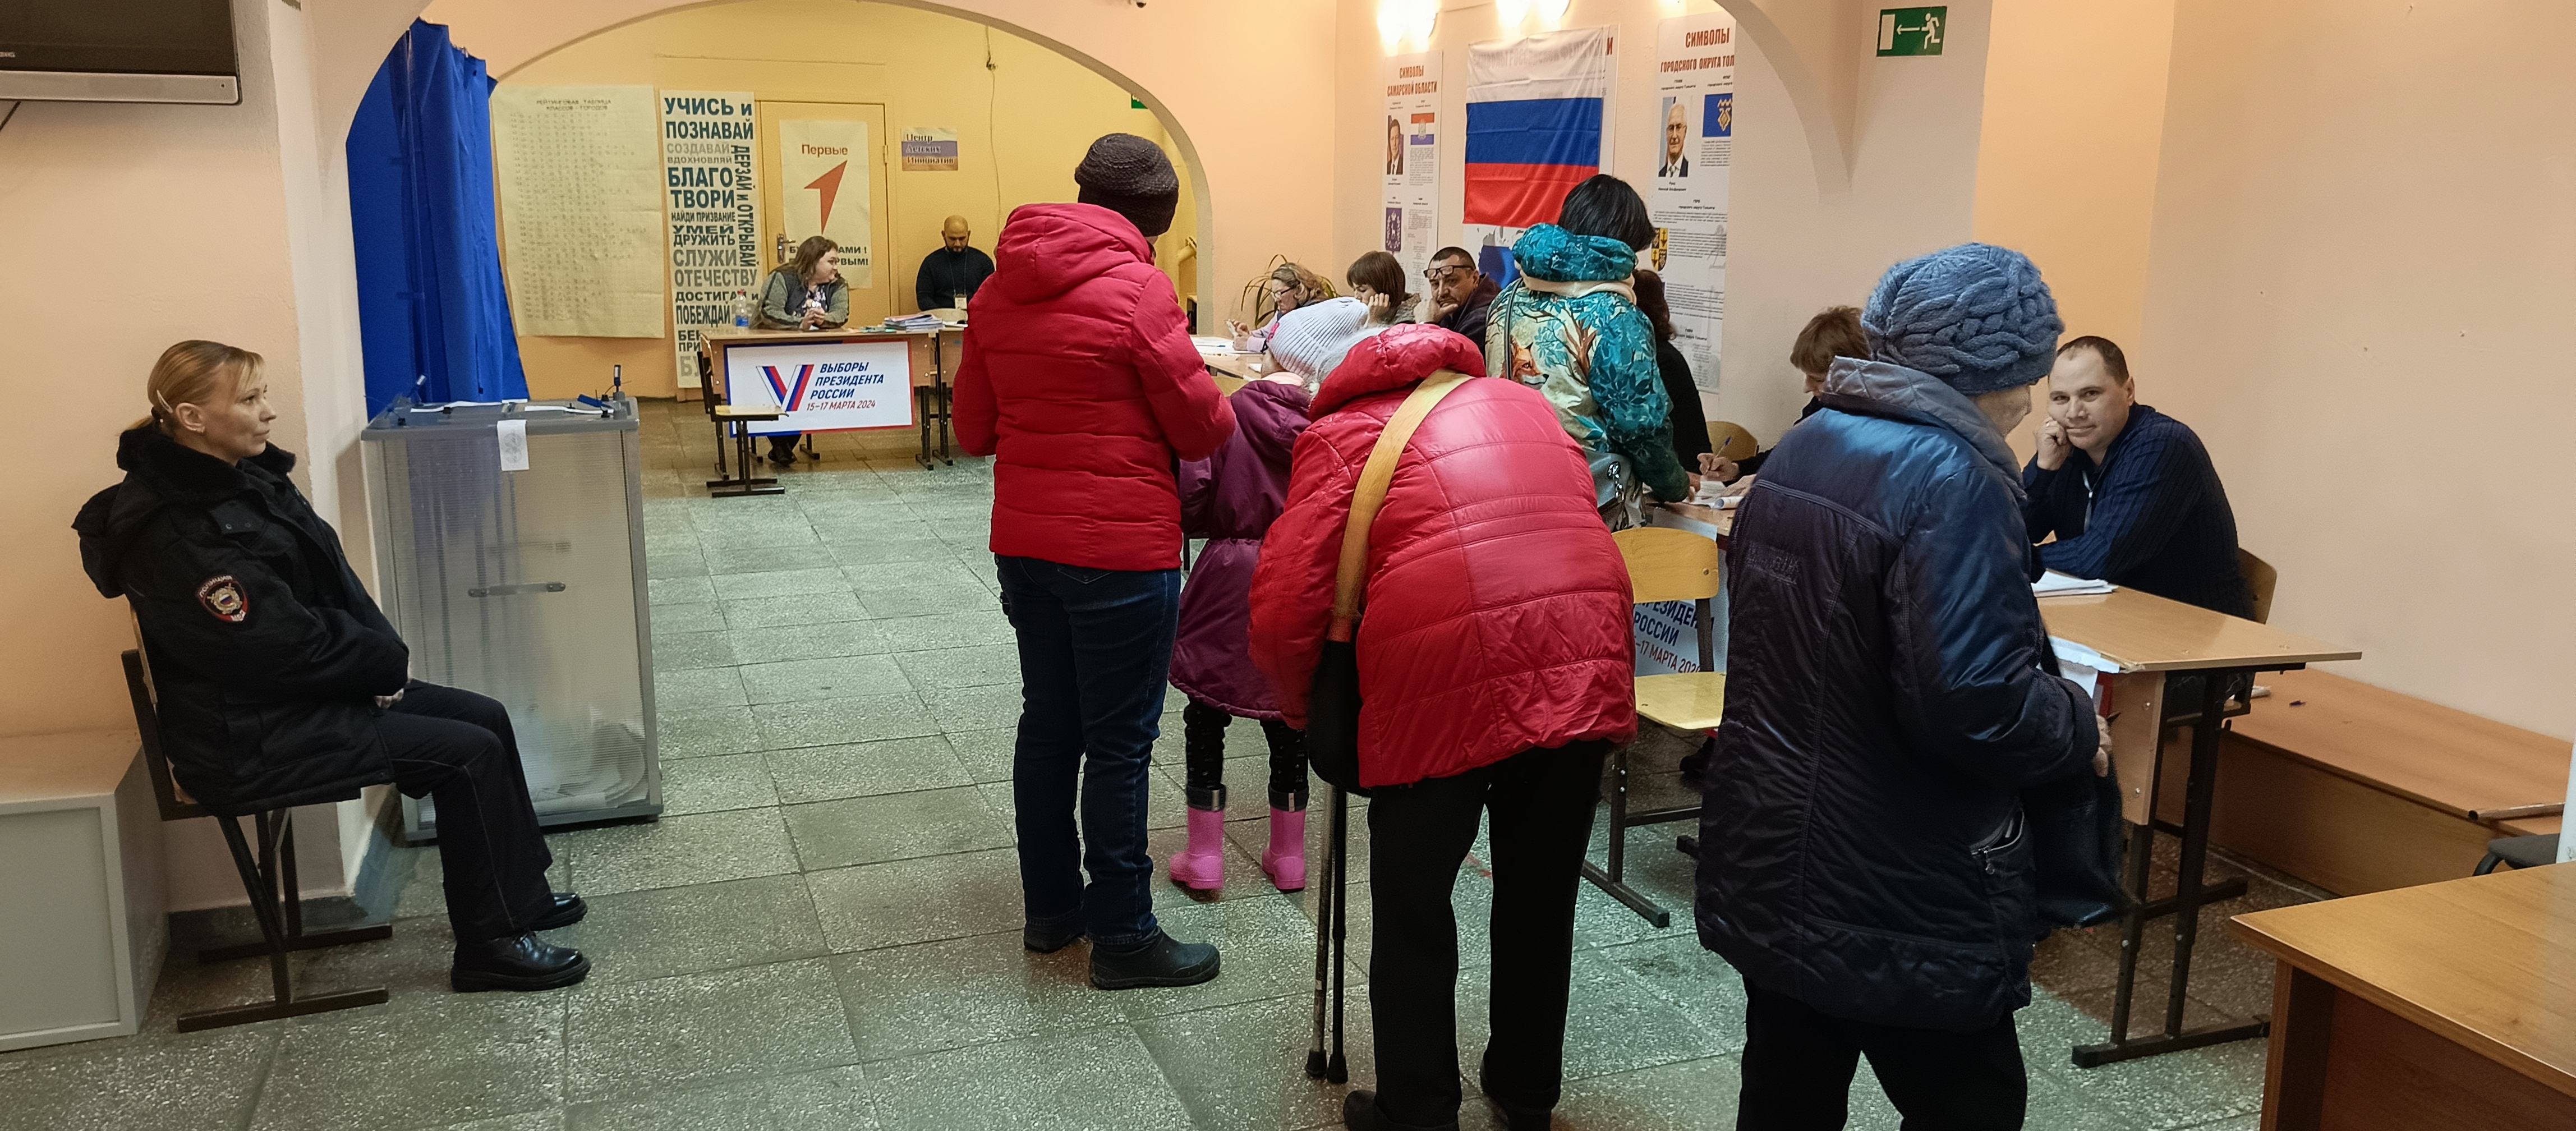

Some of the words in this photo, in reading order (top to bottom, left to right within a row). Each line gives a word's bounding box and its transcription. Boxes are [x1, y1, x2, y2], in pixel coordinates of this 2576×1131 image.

[1685, 27, 1730, 48] СИМВОЛЫ
[1399, 65, 1424, 79] СИМВОЛЫ
[1660, 58, 1697, 73] ГОРОДСКОГО
[1699, 56, 1721, 70] ОКРУГА
[1387, 81, 1414, 97] САМАРСКОЙ
[1415, 81, 1437, 95] ОБЛАСТИ
[664, 98, 734, 116] УЧИСЬ
[666, 118, 753, 140] ПОЗНАВАЙ
[907, 134, 933, 145] Центр
[667, 142, 730, 155] СОЗДАВАЙ
[802, 144, 848, 158] Первые
[731, 145, 756, 191] ДЕРЗАЙ
[668, 167, 733, 187] БЛАГО
[670, 190, 735, 209] ТВОРИ
[671, 210, 695, 223] НАЙДИ
[696, 212, 736, 223] ПРИЗВАНИЕ
[672, 224, 734, 235] УМЕЙ
[737, 204, 760, 267] ОТКРЫВАЙ
[673, 235, 735, 247] ДРУЖИТЬ
[673, 250, 737, 267] СЛУЖИ
[674, 269, 757, 287] ОТЕЧЕСТВУ
[675, 291, 747, 303] ДОСТИГА
[676, 301, 731, 328] ПОБЕЖДАЙ
[820, 362, 870, 373] ВЫБОРЫ
[815, 374, 884, 387] ПРЕЗИДЕНТА
[810, 388, 855, 399] РОССИИ
[829, 401, 855, 410] МАРТА
[857, 399, 876, 409] 2024
[1634, 612, 1680, 647] РОССИИ
[1649, 646, 1678, 670] МАРТА
